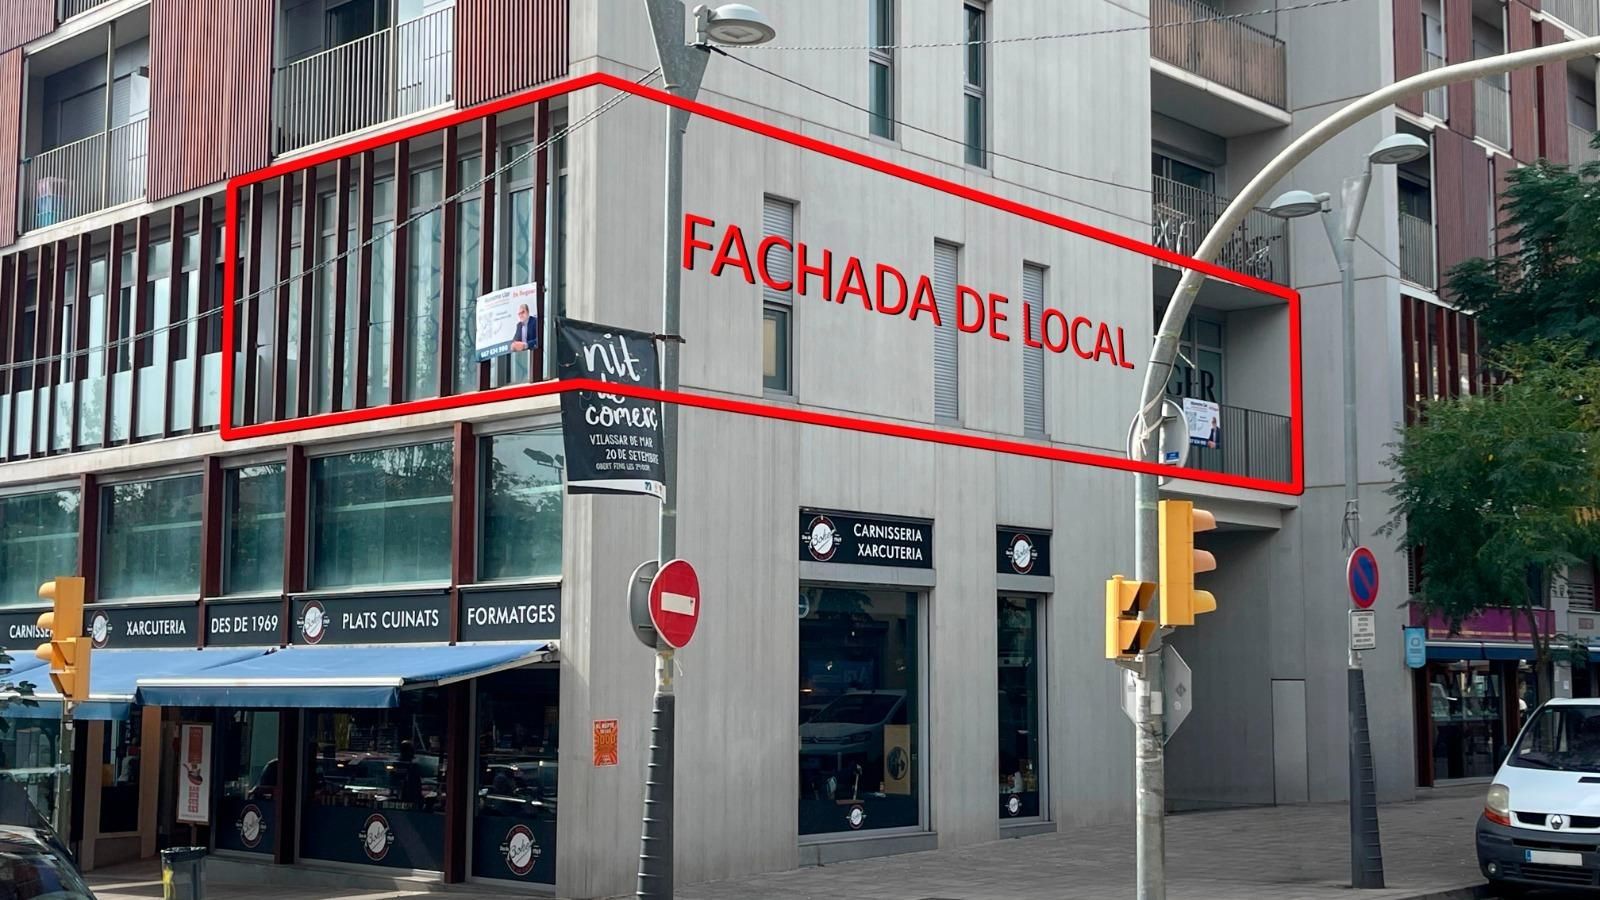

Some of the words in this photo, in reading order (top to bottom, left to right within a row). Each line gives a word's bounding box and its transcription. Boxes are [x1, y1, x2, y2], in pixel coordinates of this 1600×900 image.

[583, 333, 641, 381] nit
[585, 406, 658, 431] comerç
[589, 434, 628, 446] VILASSAR
[630, 436, 638, 447] DE
[639, 437, 653, 448] MAR
[605, 449, 617, 460] 20
[618, 449, 627, 460] DE
[629, 451, 659, 464] SETEMBRE
[853, 523, 923, 543] CARNISSERIA
[857, 543, 923, 561] XARCUTERIA
[211, 617, 230, 634] DES
[233, 616, 248, 633] DE
[251, 614, 279, 632] 1969
[342, 612, 377, 630] PLATS
[381, 608, 439, 628] CUINATS
[467, 603, 556, 626] FORMATGES
[126, 620, 186, 636] XARCUTERIA
